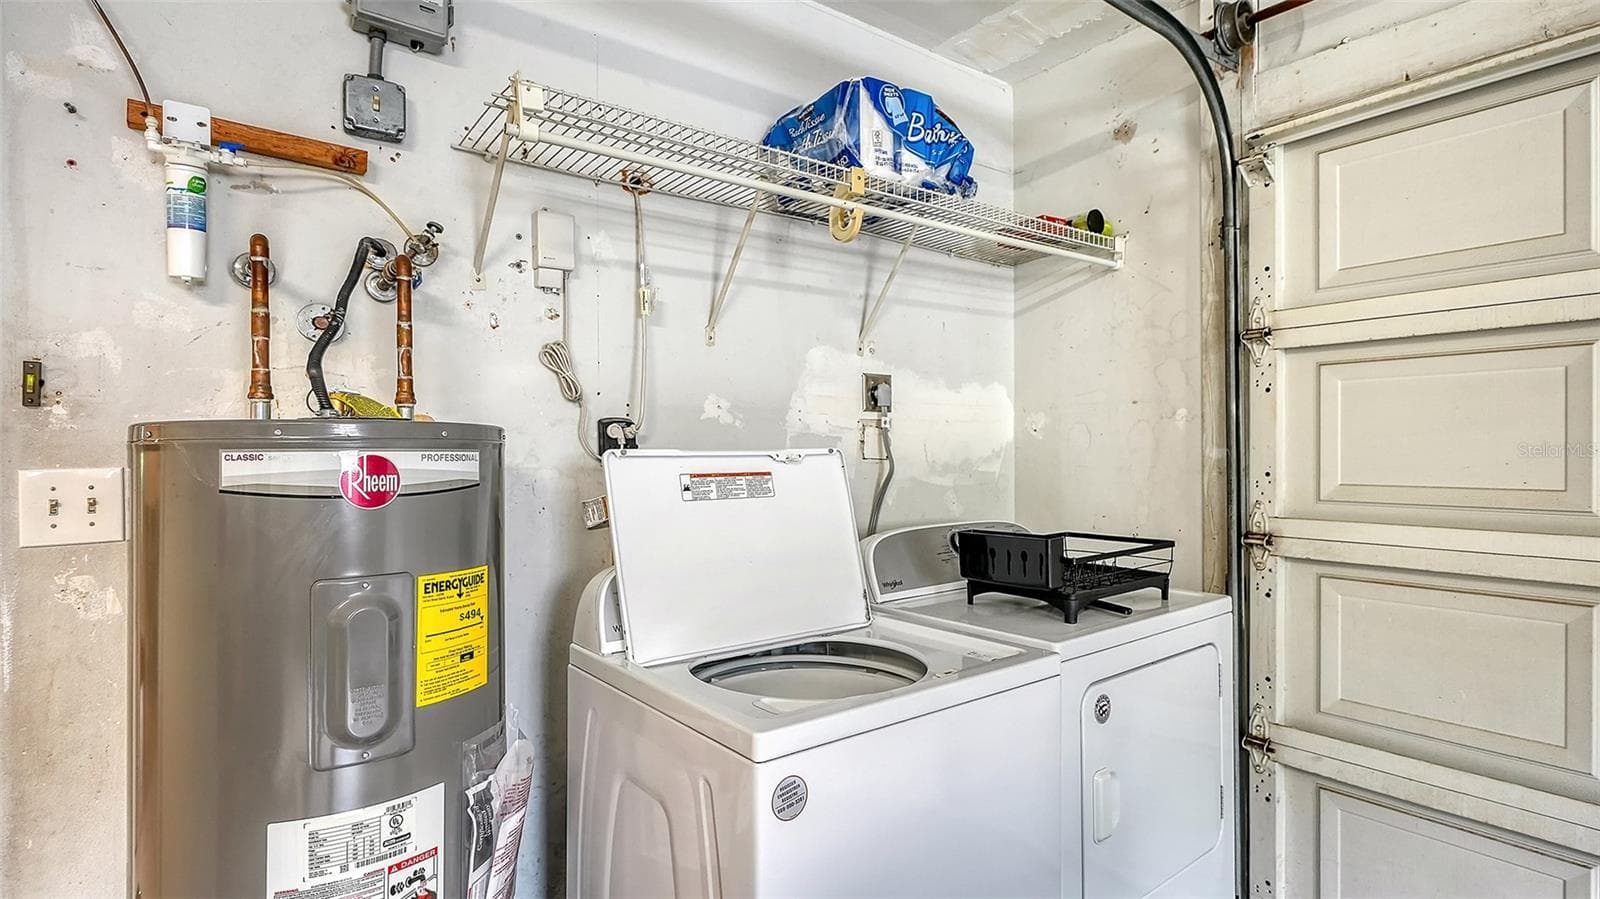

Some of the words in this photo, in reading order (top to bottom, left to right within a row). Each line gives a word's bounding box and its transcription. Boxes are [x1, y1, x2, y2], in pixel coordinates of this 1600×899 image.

[223, 453, 264, 462] CLASSIC
[420, 453, 479, 462] PROFESSIONAL
[349, 455, 398, 500] Rheem
[459, 607, 481, 622] $494
[399, 848, 437, 870] DANGER
